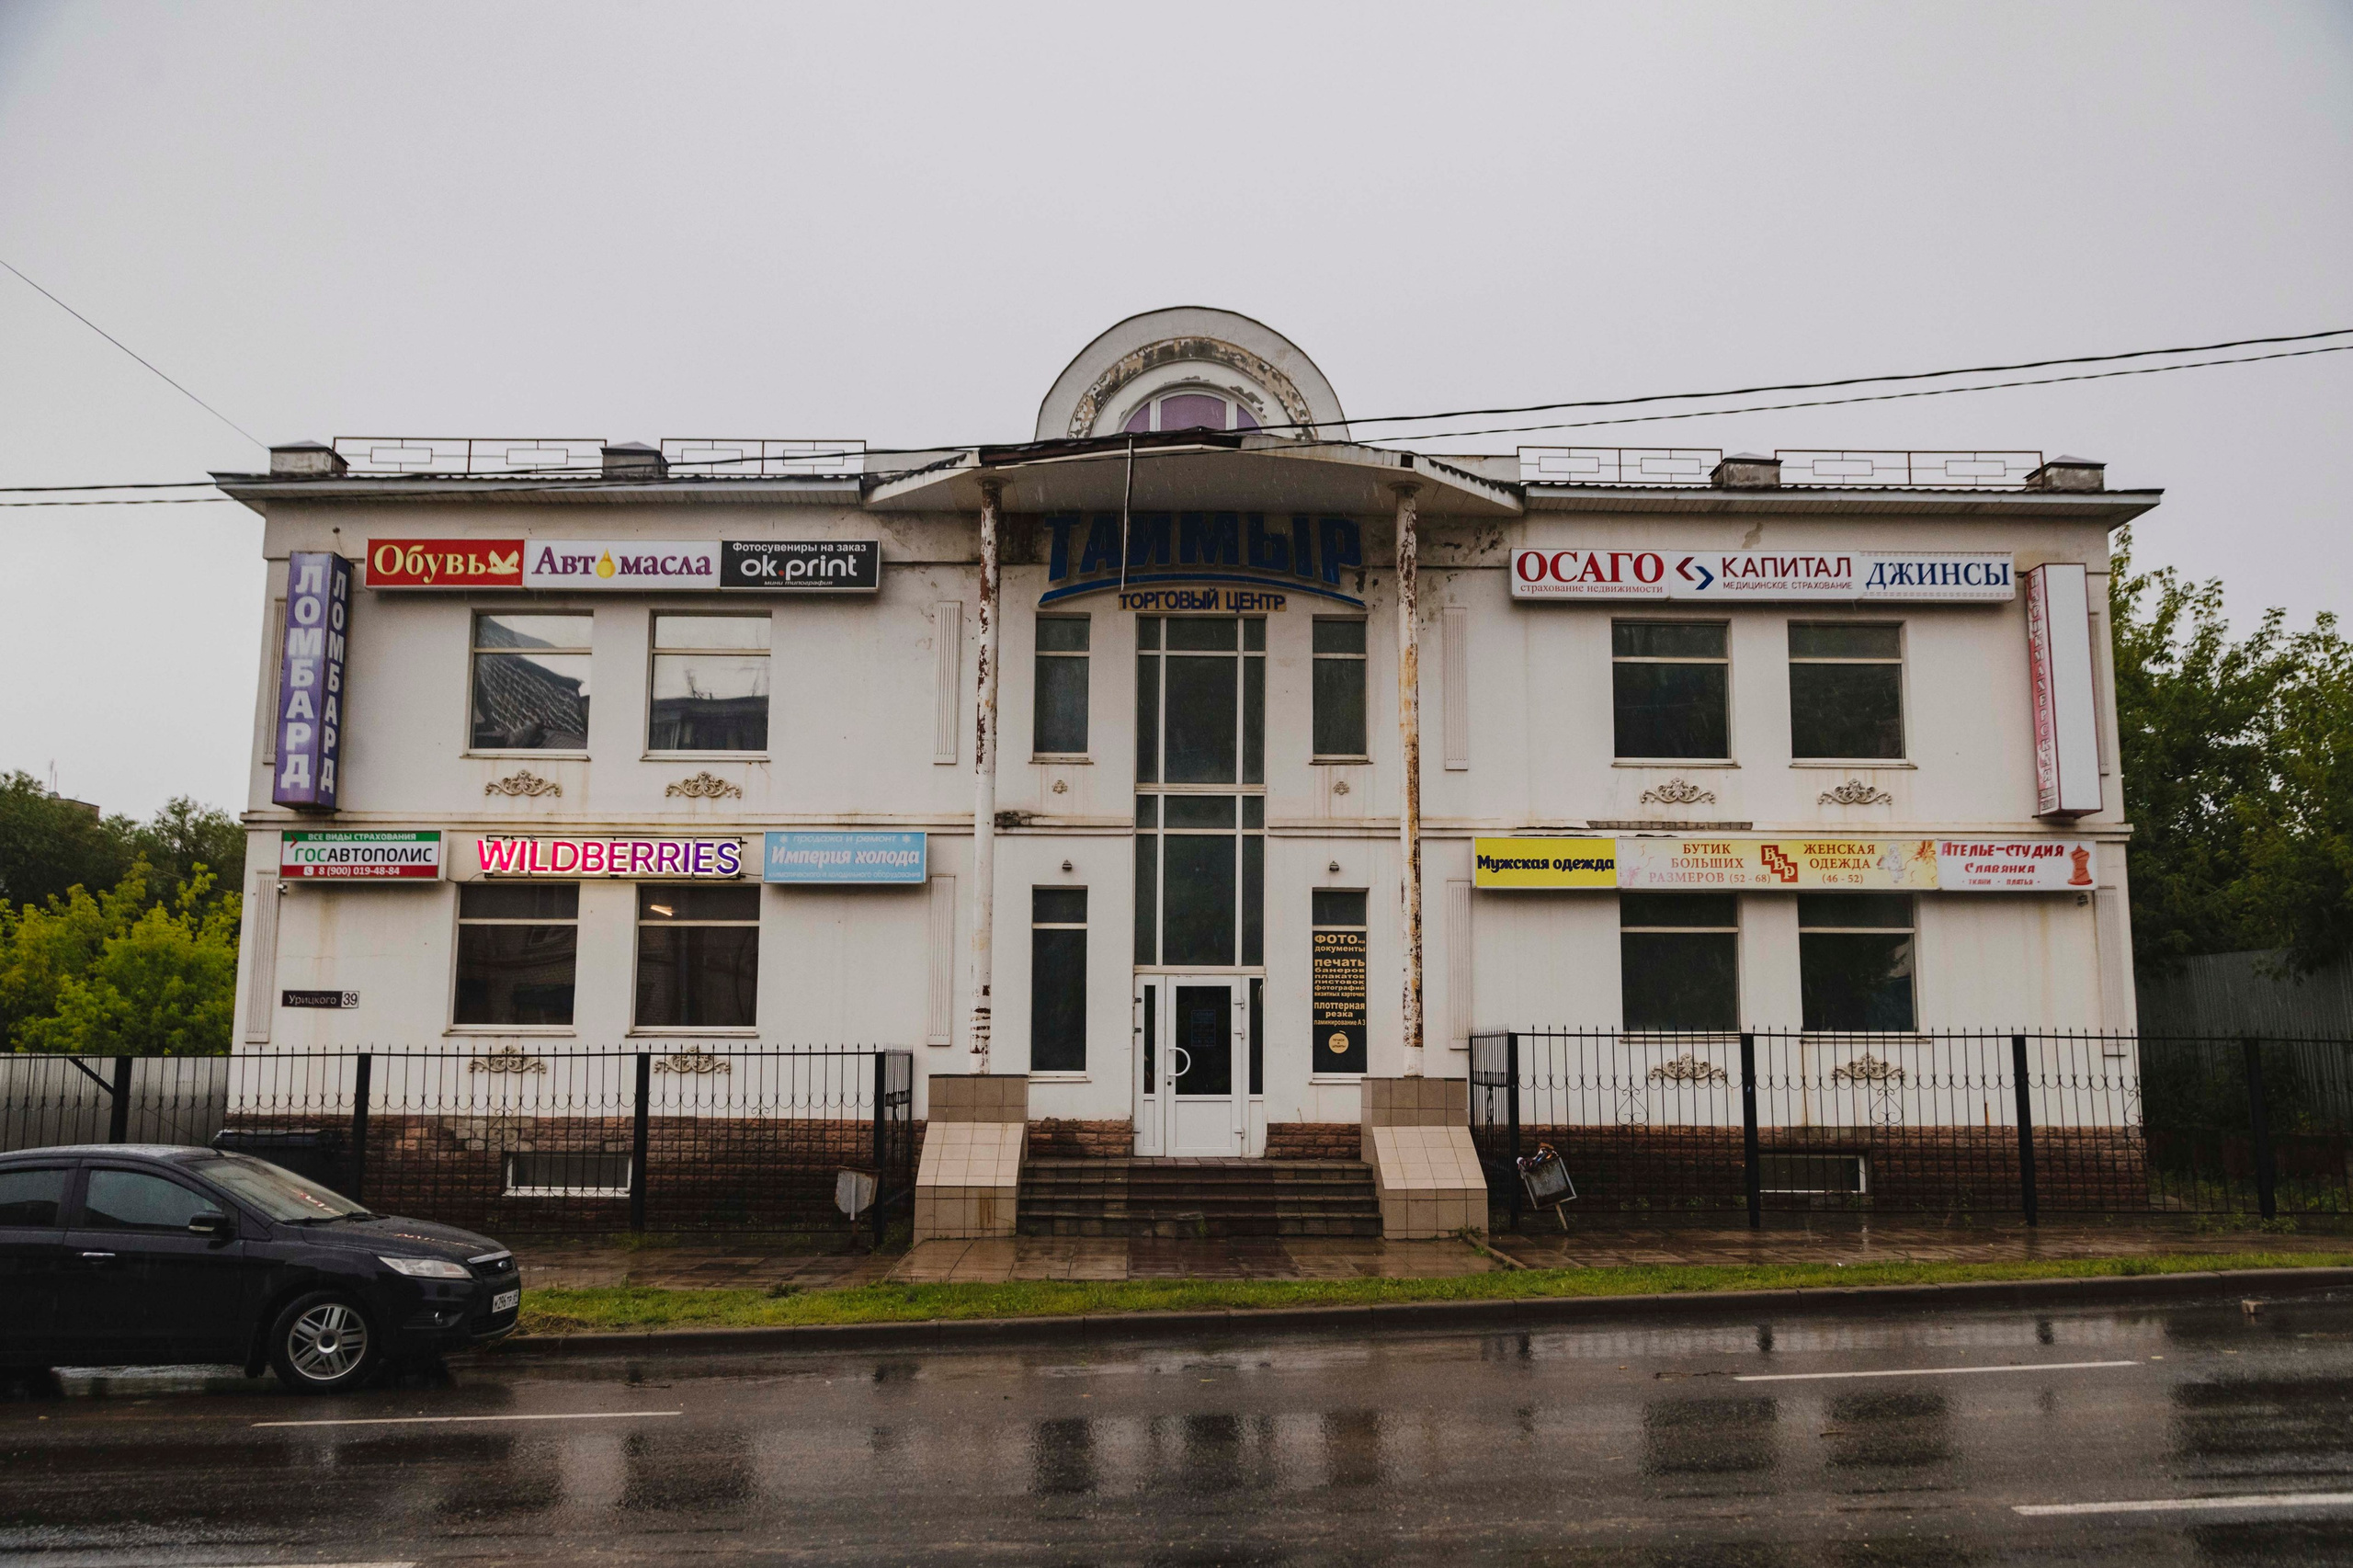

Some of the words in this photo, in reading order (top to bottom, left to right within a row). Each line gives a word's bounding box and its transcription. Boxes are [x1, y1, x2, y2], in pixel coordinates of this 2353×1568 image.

[733, 542, 817, 553] Фотосувениры
[373, 544, 486, 584] Обувь
[740, 554, 858, 580] ok.print
[1517, 551, 1665, 583] ОСАГО
[1722, 557, 1852, 577] КАПИТАЛ
[1866, 562, 2009, 590] ДЖИНСЫ
[1520, 584, 1584, 593] страхование
[1586, 585, 1663, 593] недвижимости
[1723, 581, 1788, 590] МЕДИЦИНСКОЕ
[1791, 581, 1852, 589] СТРАХОВАНИЕ
[1119, 588, 1219, 610] ТОРГОВЫЙ
[1226, 591, 1285, 613] ЦЕНТР
[280, 565, 321, 789] ЛОМБАРД
[320, 570, 347, 794] ЛОМБАРД
[2029, 574, 2052, 783] ПАРИКМАХЕРСКАЯ
[324, 834, 352, 842] ВИДЫ
[294, 847, 432, 862] ГОСАВТОПОЛИС
[1682, 844, 1731, 854] БУТИК
[1803, 844, 1875, 855] ЖЕНСКАЯ
[477, 839, 741, 873] WILDBERRIES
[771, 846, 851, 868] Империя
[855, 850, 919, 867] холода
[1477, 855, 1549, 873] Мужская
[1552, 857, 1615, 872] одежда
[1670, 858, 1745, 869] БОЛЬШИХ
[1810, 858, 1871, 869] ОДЕЖДА
[318, 867, 324, 875] 8
[327, 866, 351, 876] (900)
[353, 867, 400, 875] 019-48-84
[1649, 872, 1725, 882] РАЗМЕРОВ
[1729, 873, 1745, 884] (52
[1756, 873, 1771, 884] 68)
[1822, 873, 1838, 884] (46
[1847, 873, 1863, 884] 52)
[1314, 934, 1358, 944] ФОТО
[1314, 959, 1365, 967] печать
[289, 994, 336, 1006] Урицкого
[343, 993, 358, 1006] 39
[1314, 1002, 1365, 1011] плоттерная
